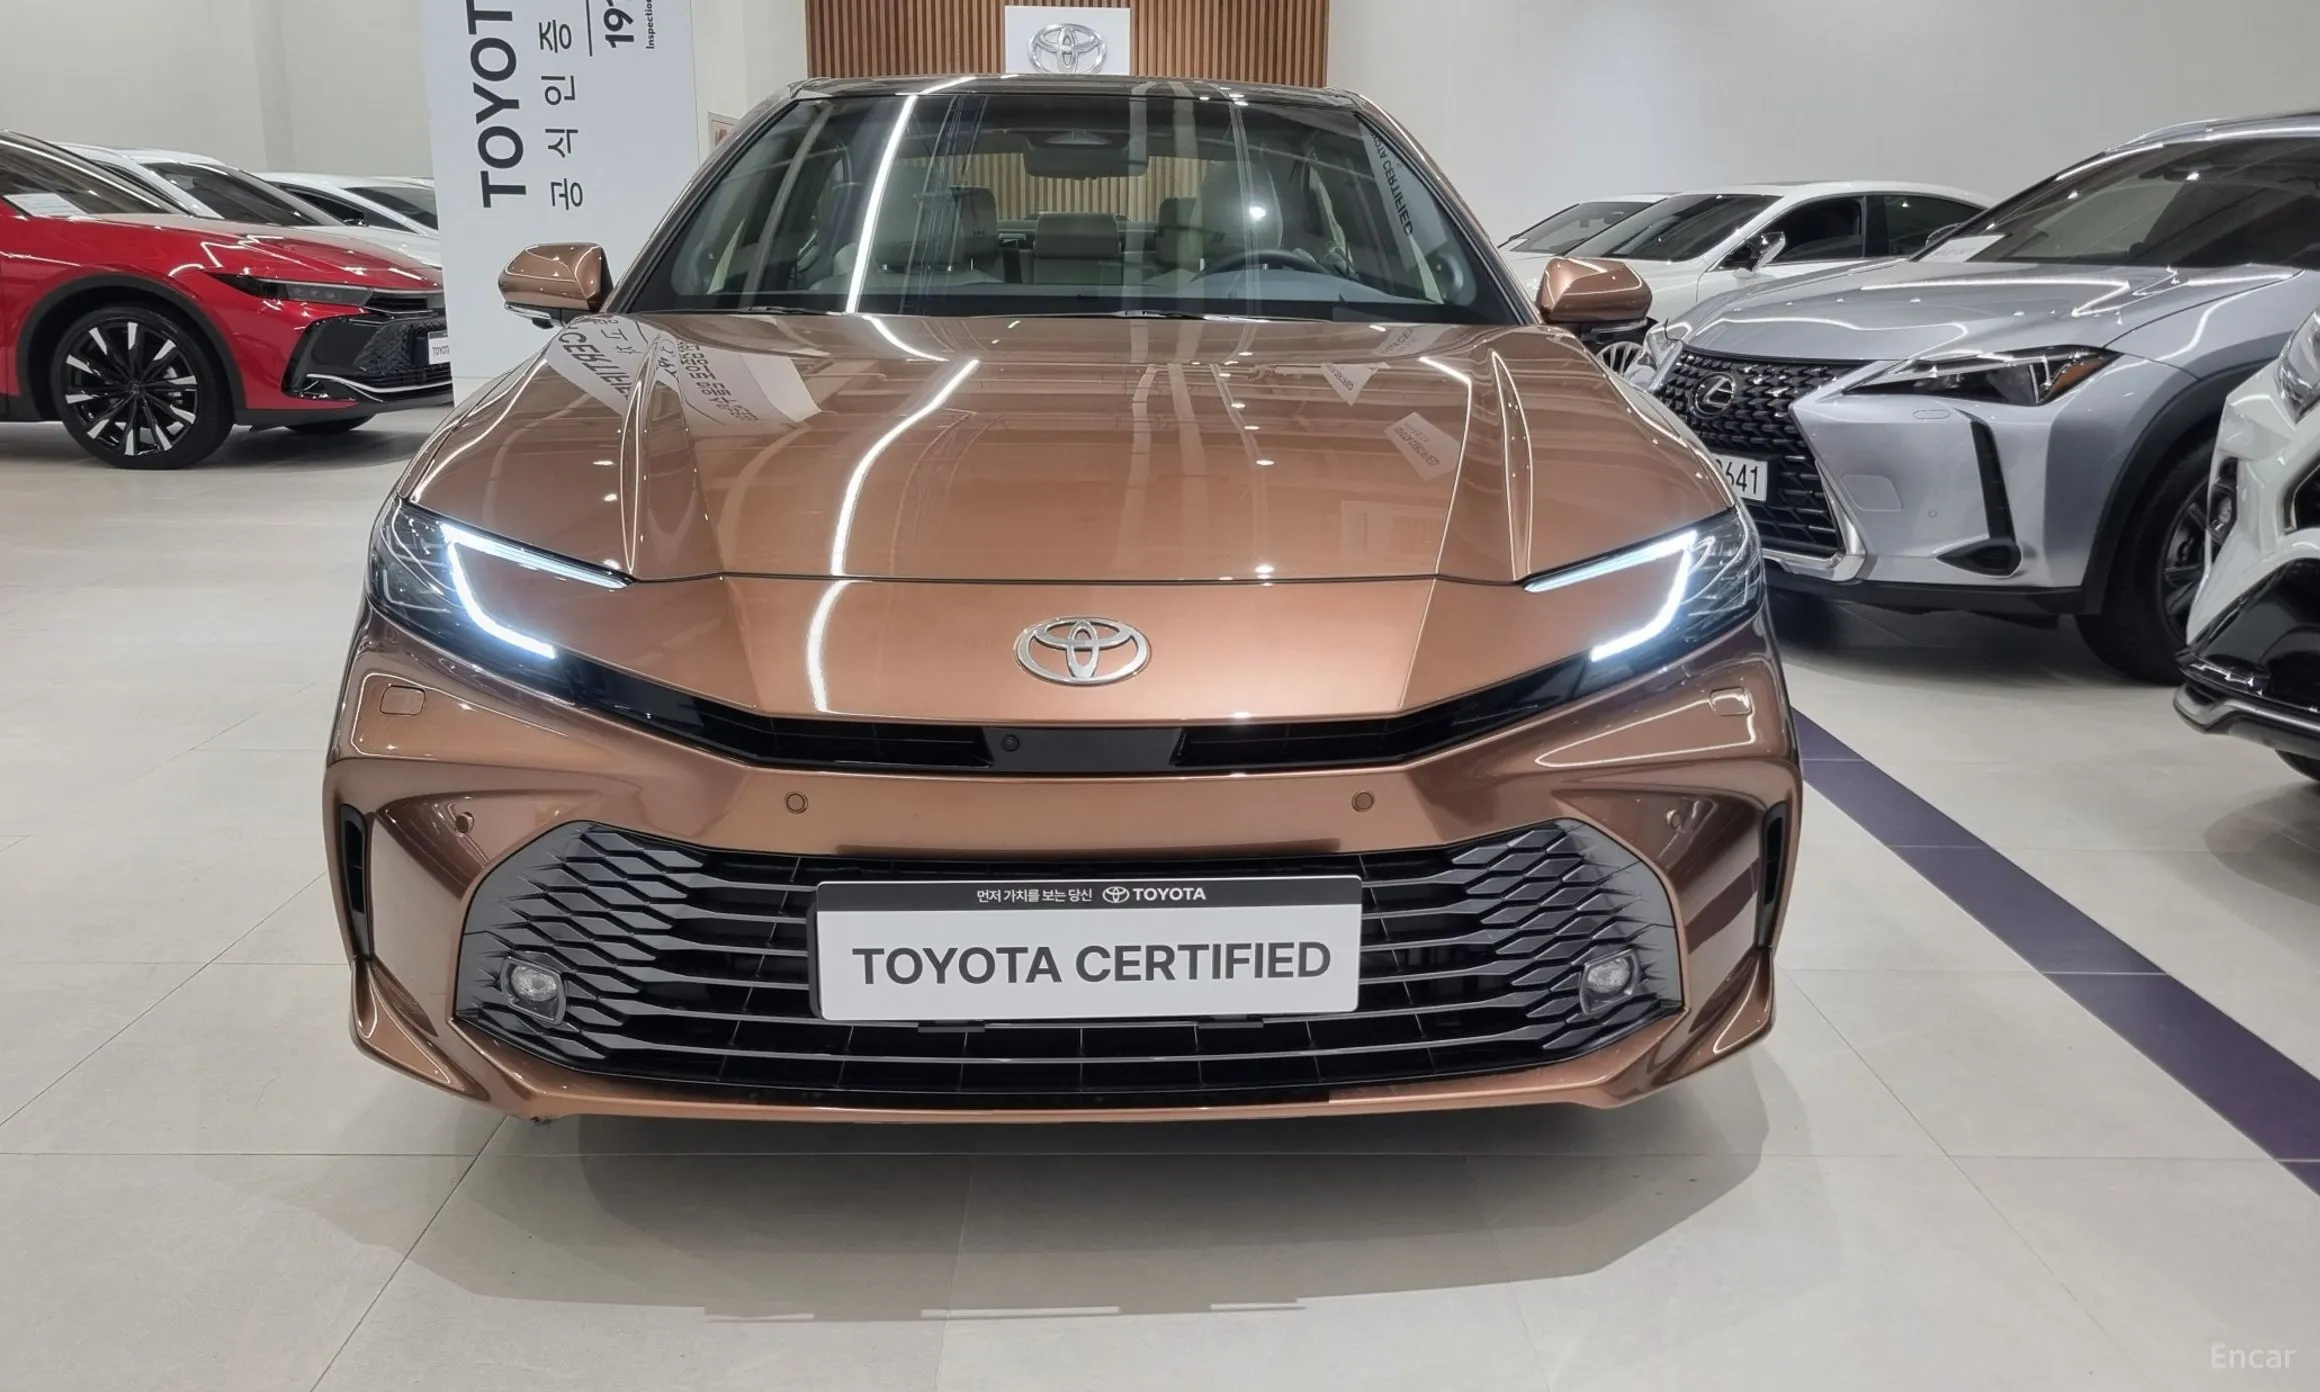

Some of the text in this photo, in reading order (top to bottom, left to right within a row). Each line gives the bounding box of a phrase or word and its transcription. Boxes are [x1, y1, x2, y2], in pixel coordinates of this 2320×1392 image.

[603, 0, 634, 48] 19
[977, 888, 1093, 903] 먼저 가치를 보는 당신
[1132, 887, 1207, 901] TOYOTA
[852, 941, 1331, 985] TOYOTA CERTIFIED
